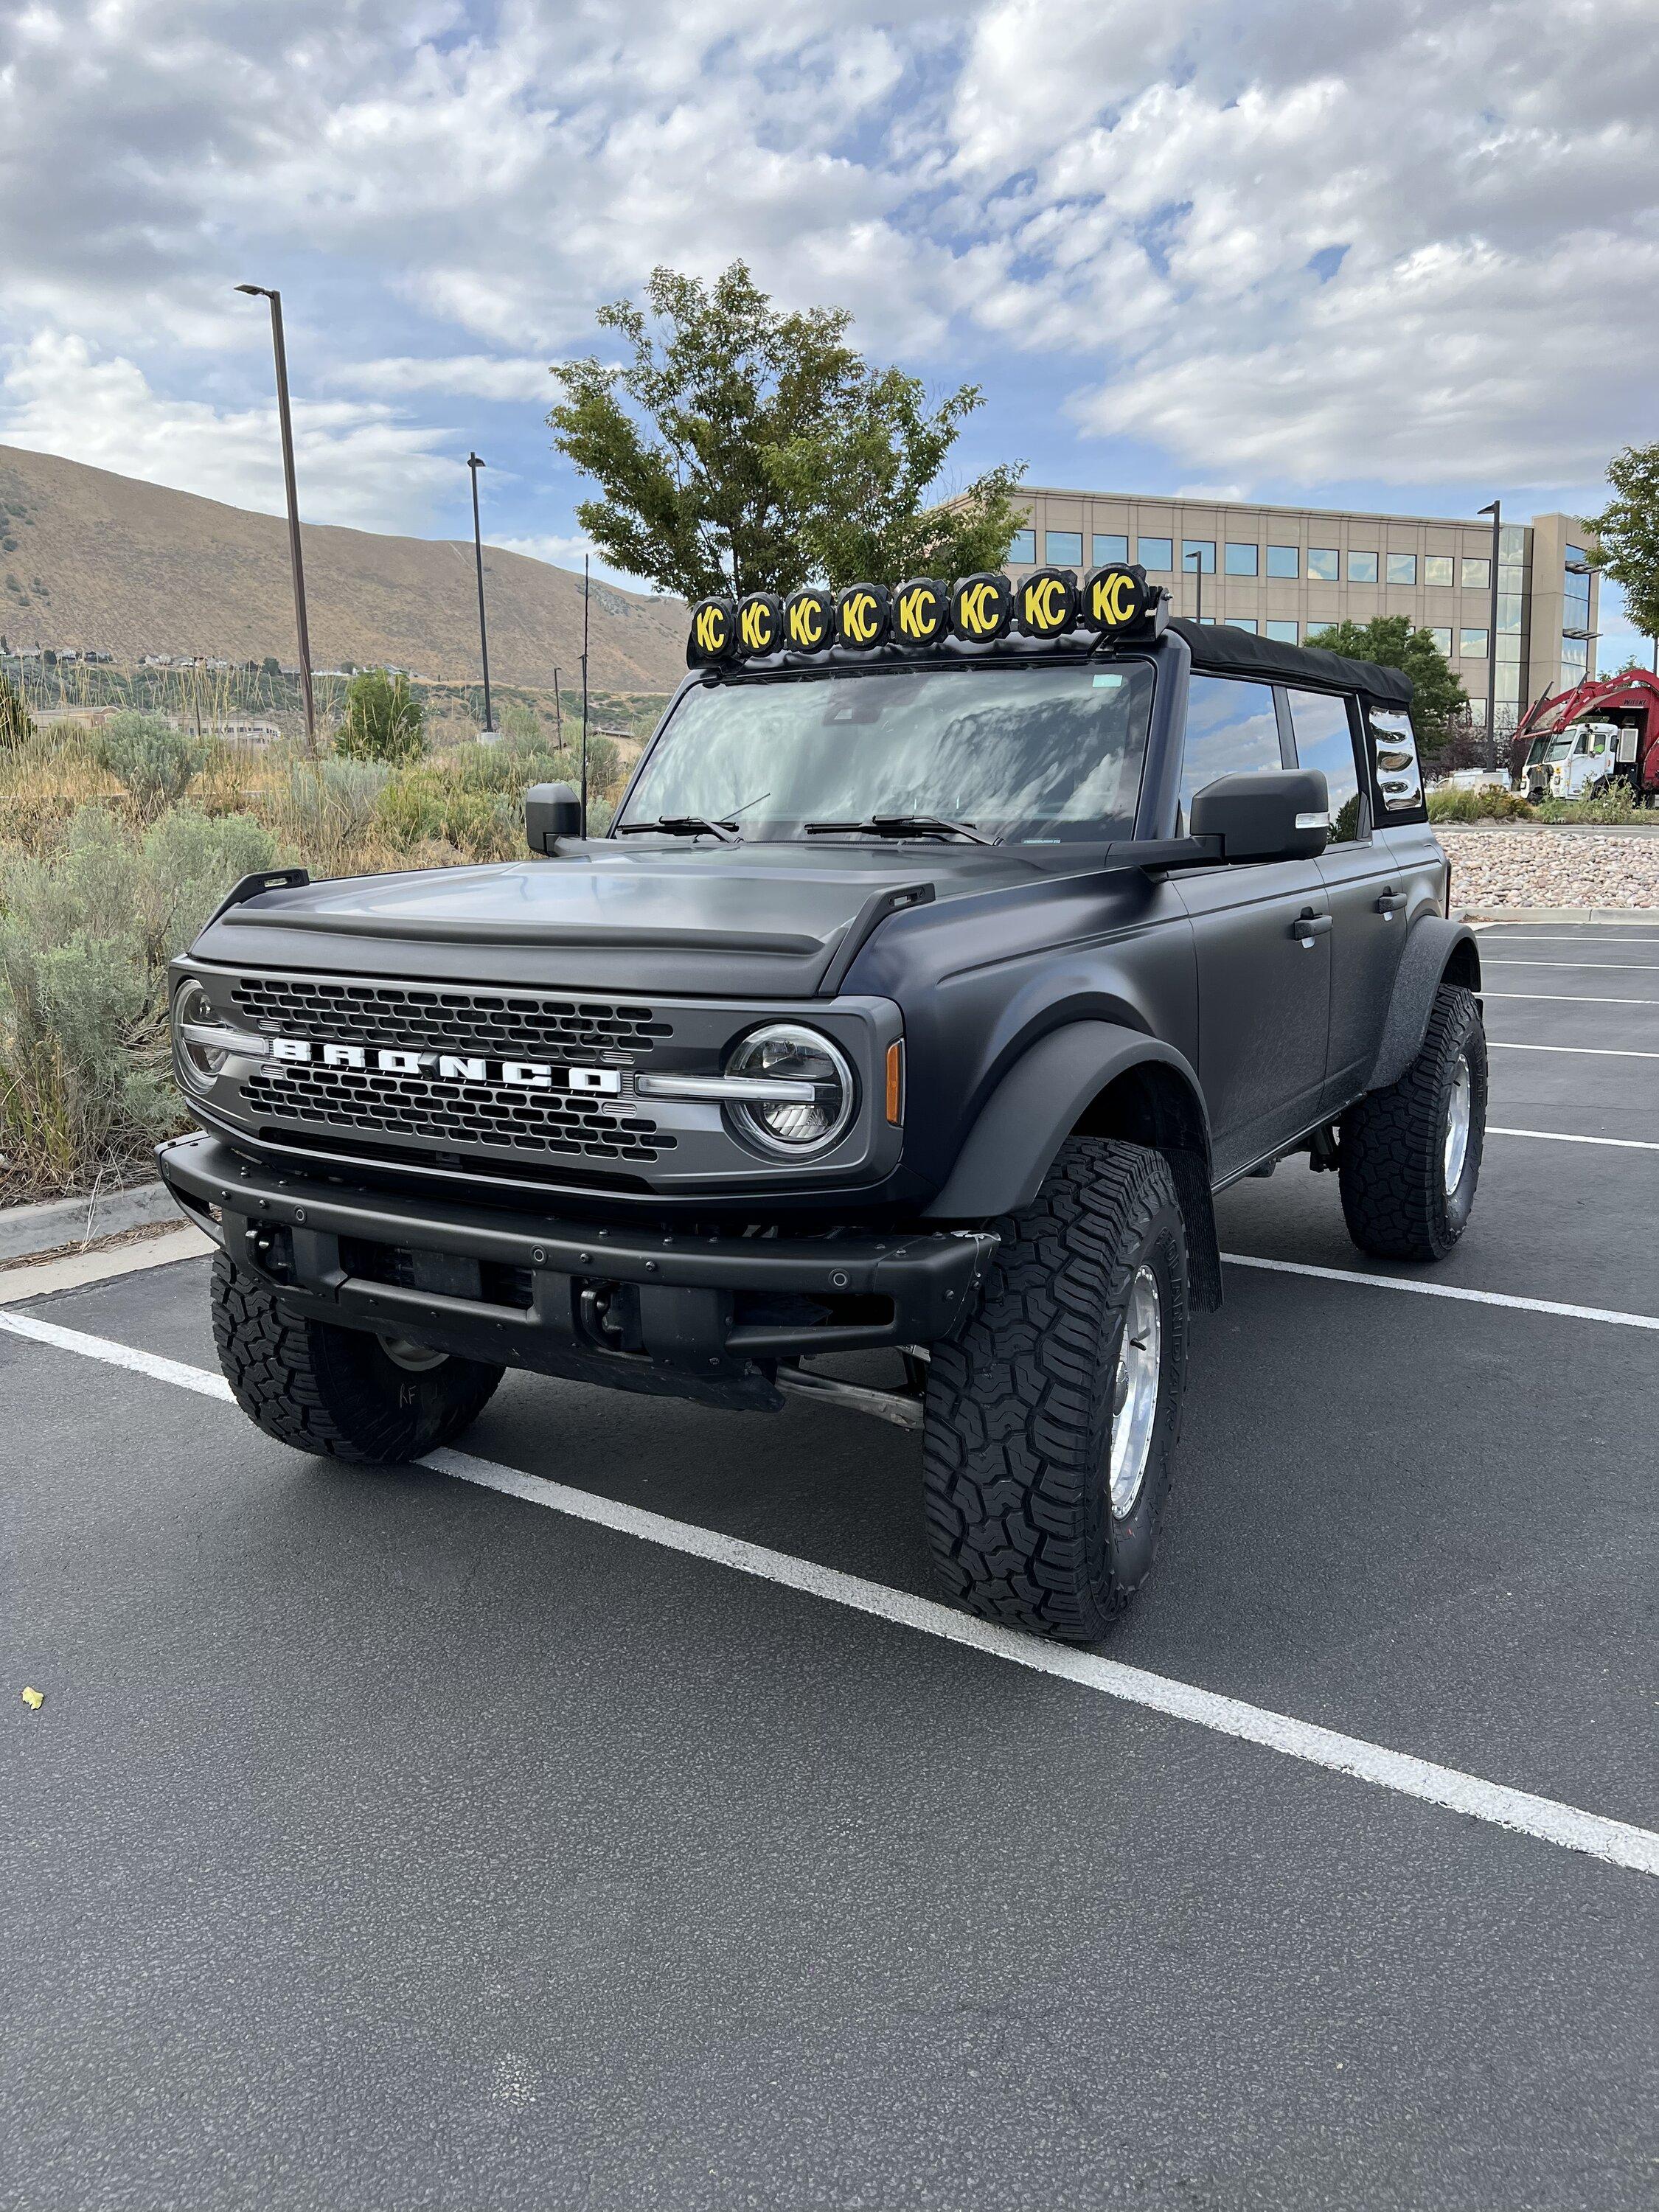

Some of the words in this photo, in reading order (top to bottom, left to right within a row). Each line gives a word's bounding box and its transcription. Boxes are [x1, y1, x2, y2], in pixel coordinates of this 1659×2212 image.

[790, 598, 821, 644] KC
[844, 595, 877, 641] KC
[900, 588, 935, 637] KC
[961, 583, 998, 633] KC
[1026, 578, 1063, 629] KC
[1093, 573, 1134, 625] KC
[697, 608, 724, 649] KC
[742, 605, 771, 648] KC
[273, 1037, 622, 1093] BRONCO
